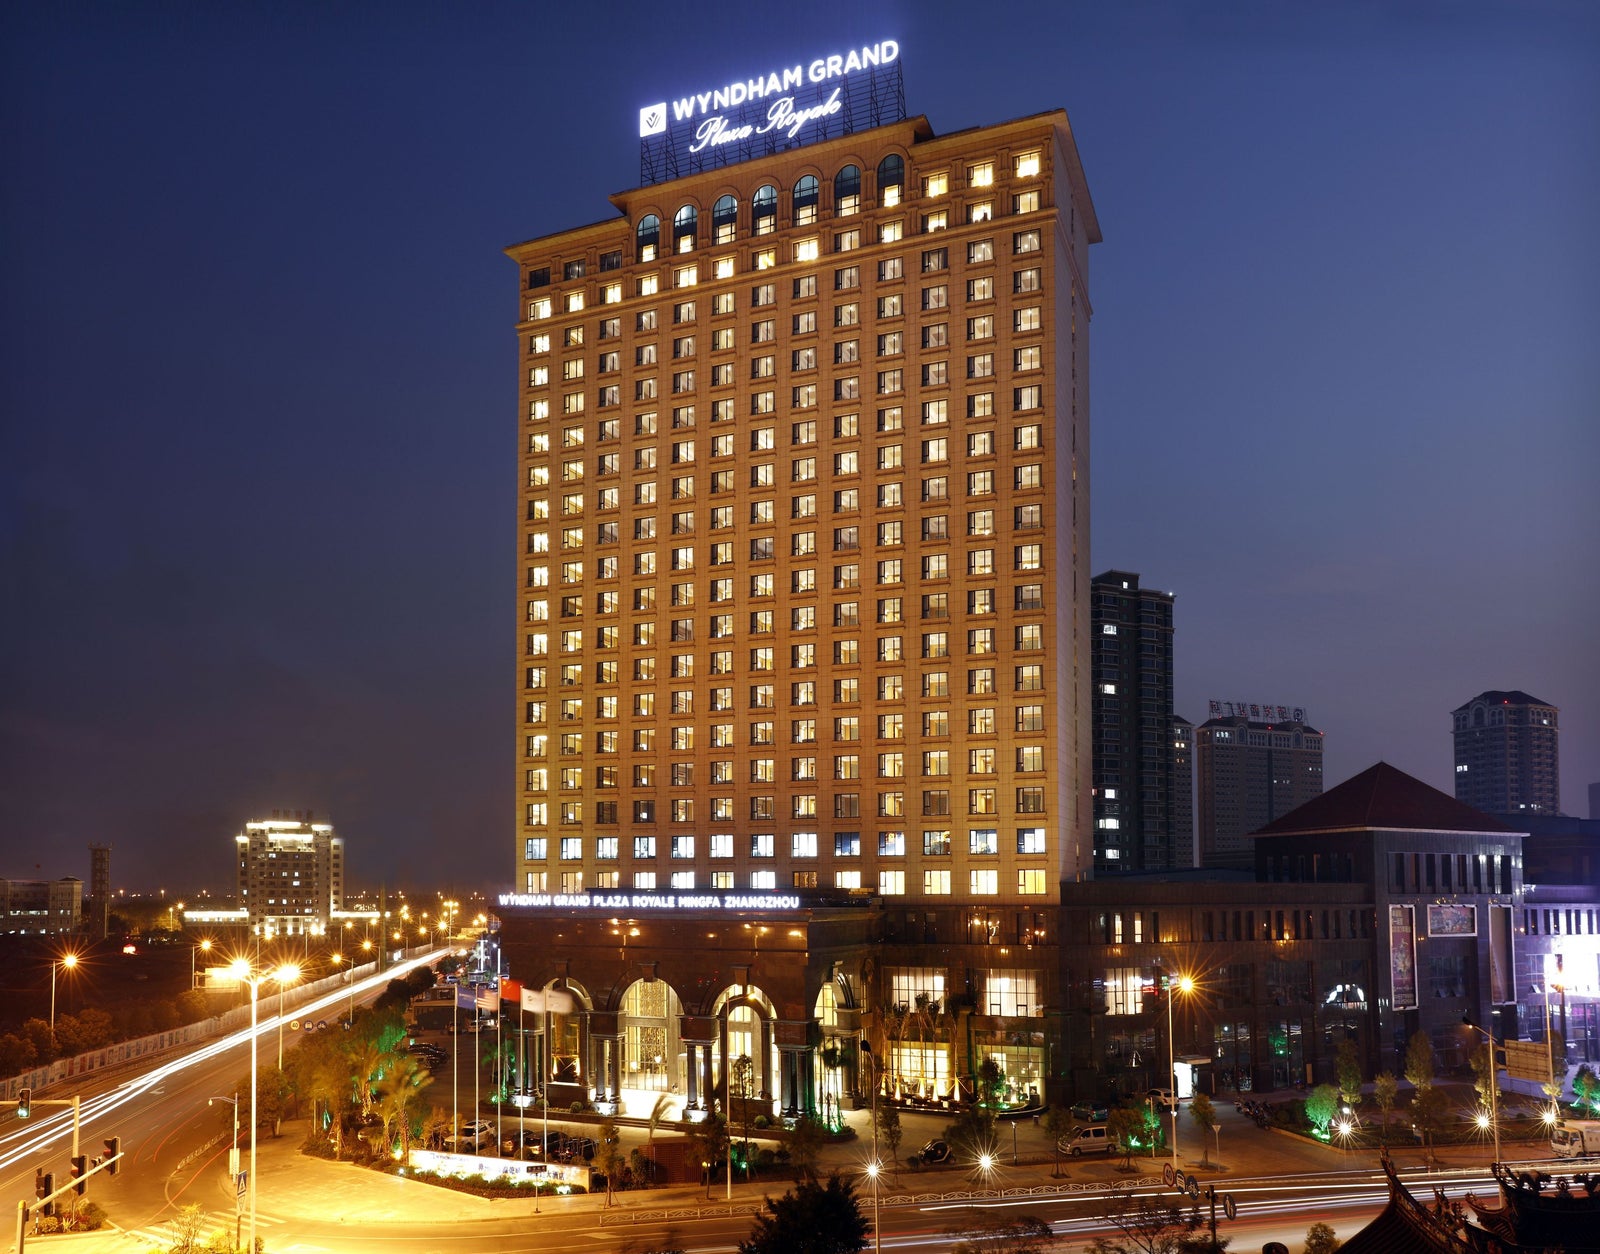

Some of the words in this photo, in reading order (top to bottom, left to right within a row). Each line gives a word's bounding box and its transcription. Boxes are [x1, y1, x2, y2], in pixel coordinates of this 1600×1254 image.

[673, 64, 802, 121] WYNDHAM
[808, 40, 899, 83] GRAND
[689, 115, 753, 153] Plaza
[756, 87, 842, 138] Royale
[498, 893, 551, 906] WYNDHAM
[553, 894, 591, 907] GRAND
[593, 895, 630, 907] PLAZA
[632, 895, 675, 908] ROYALE
[678, 896, 721, 908] MINGFA
[724, 896, 799, 909] ZHANGZHOU
